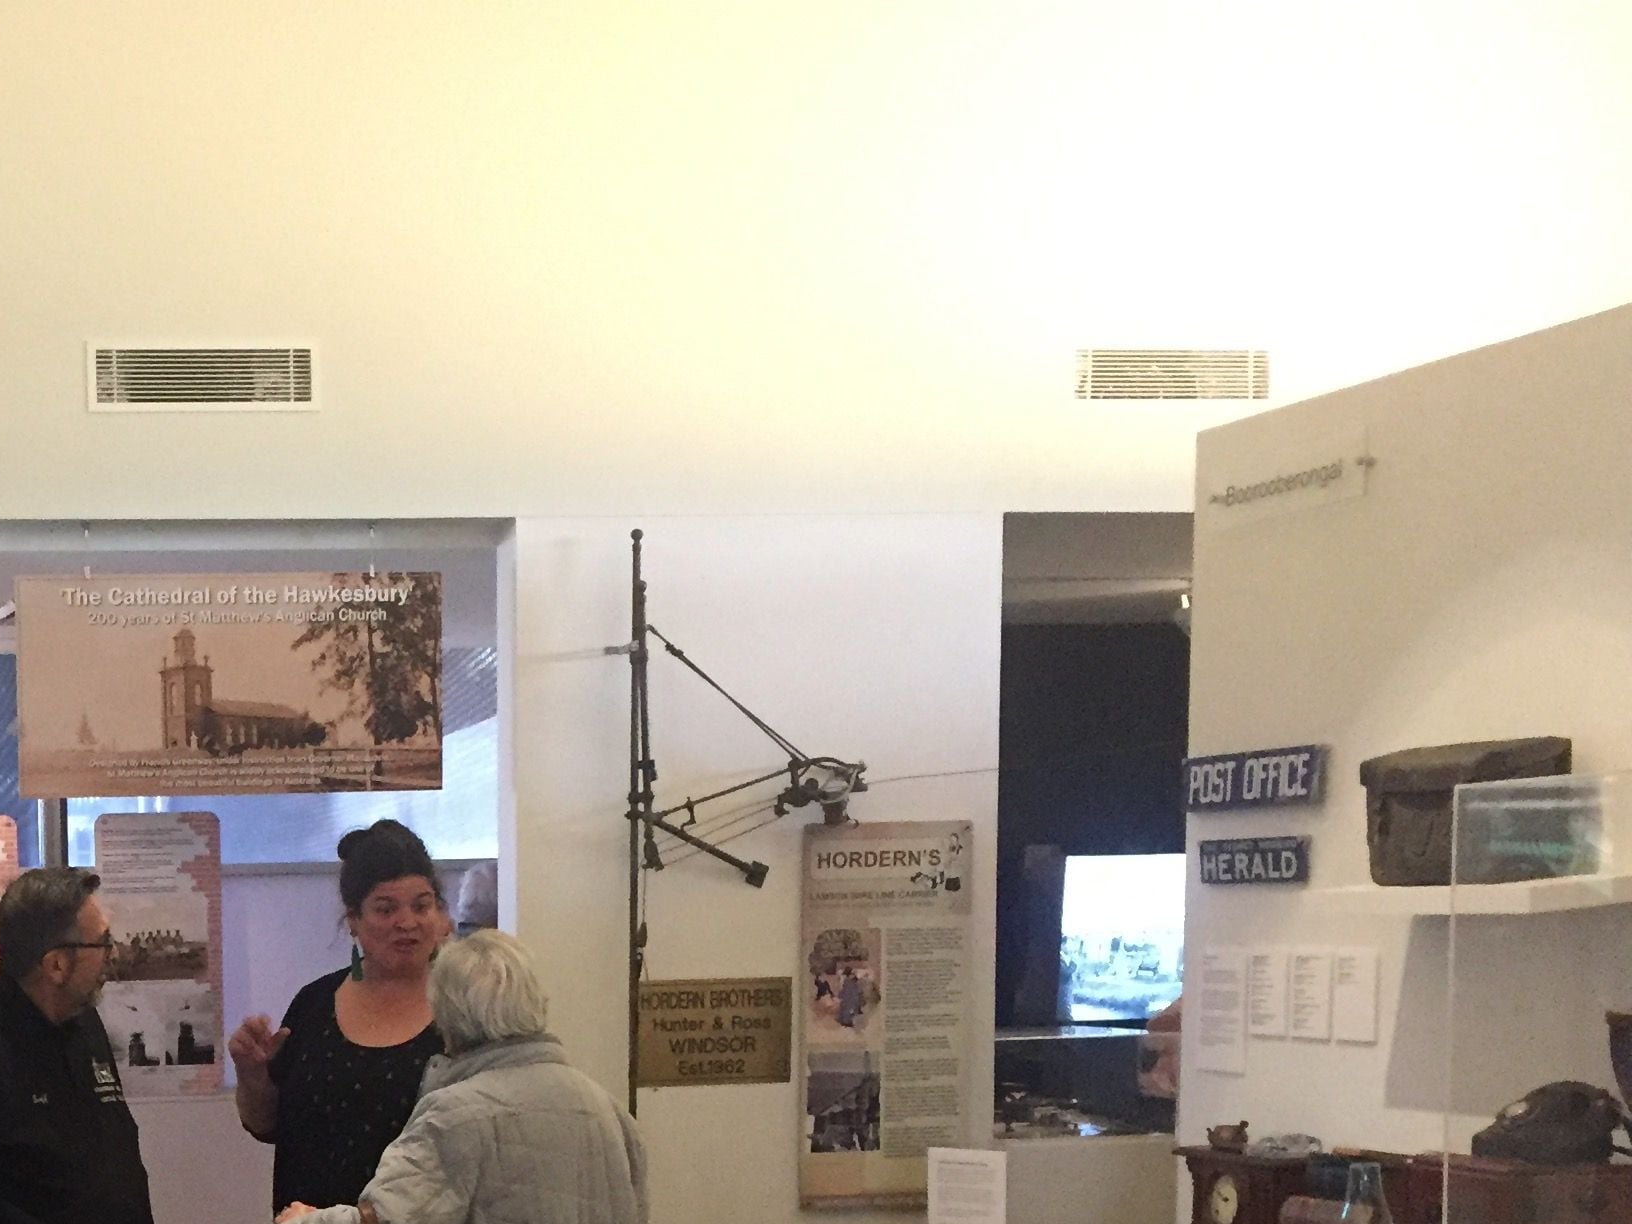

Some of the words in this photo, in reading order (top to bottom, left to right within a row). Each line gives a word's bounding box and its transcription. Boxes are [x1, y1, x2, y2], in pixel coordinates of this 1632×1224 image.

[108, 585, 211, 607] Cathedral
[217, 585, 238, 605] of
[243, 585, 277, 605] the
[88, 612, 119, 626] 200
[121, 615, 161, 628] years
[181, 610, 196, 625] St
[275, 609, 335, 625] Anglican
[338, 607, 388, 622] Church
[1188, 761, 1236, 804] POST
[1243, 753, 1310, 800] OFFICE
[817, 849, 942, 869] HORDERN'S
[1202, 851, 1298, 881] HERALD
[640, 990, 706, 1011] HORDERN
[709, 988, 784, 1010] BROTHERS
[652, 1018, 706, 1033] Hunter
[712, 1016, 724, 1030] &
[731, 1015, 773, 1030] Ross
[668, 1036, 757, 1054] WINDSOR
